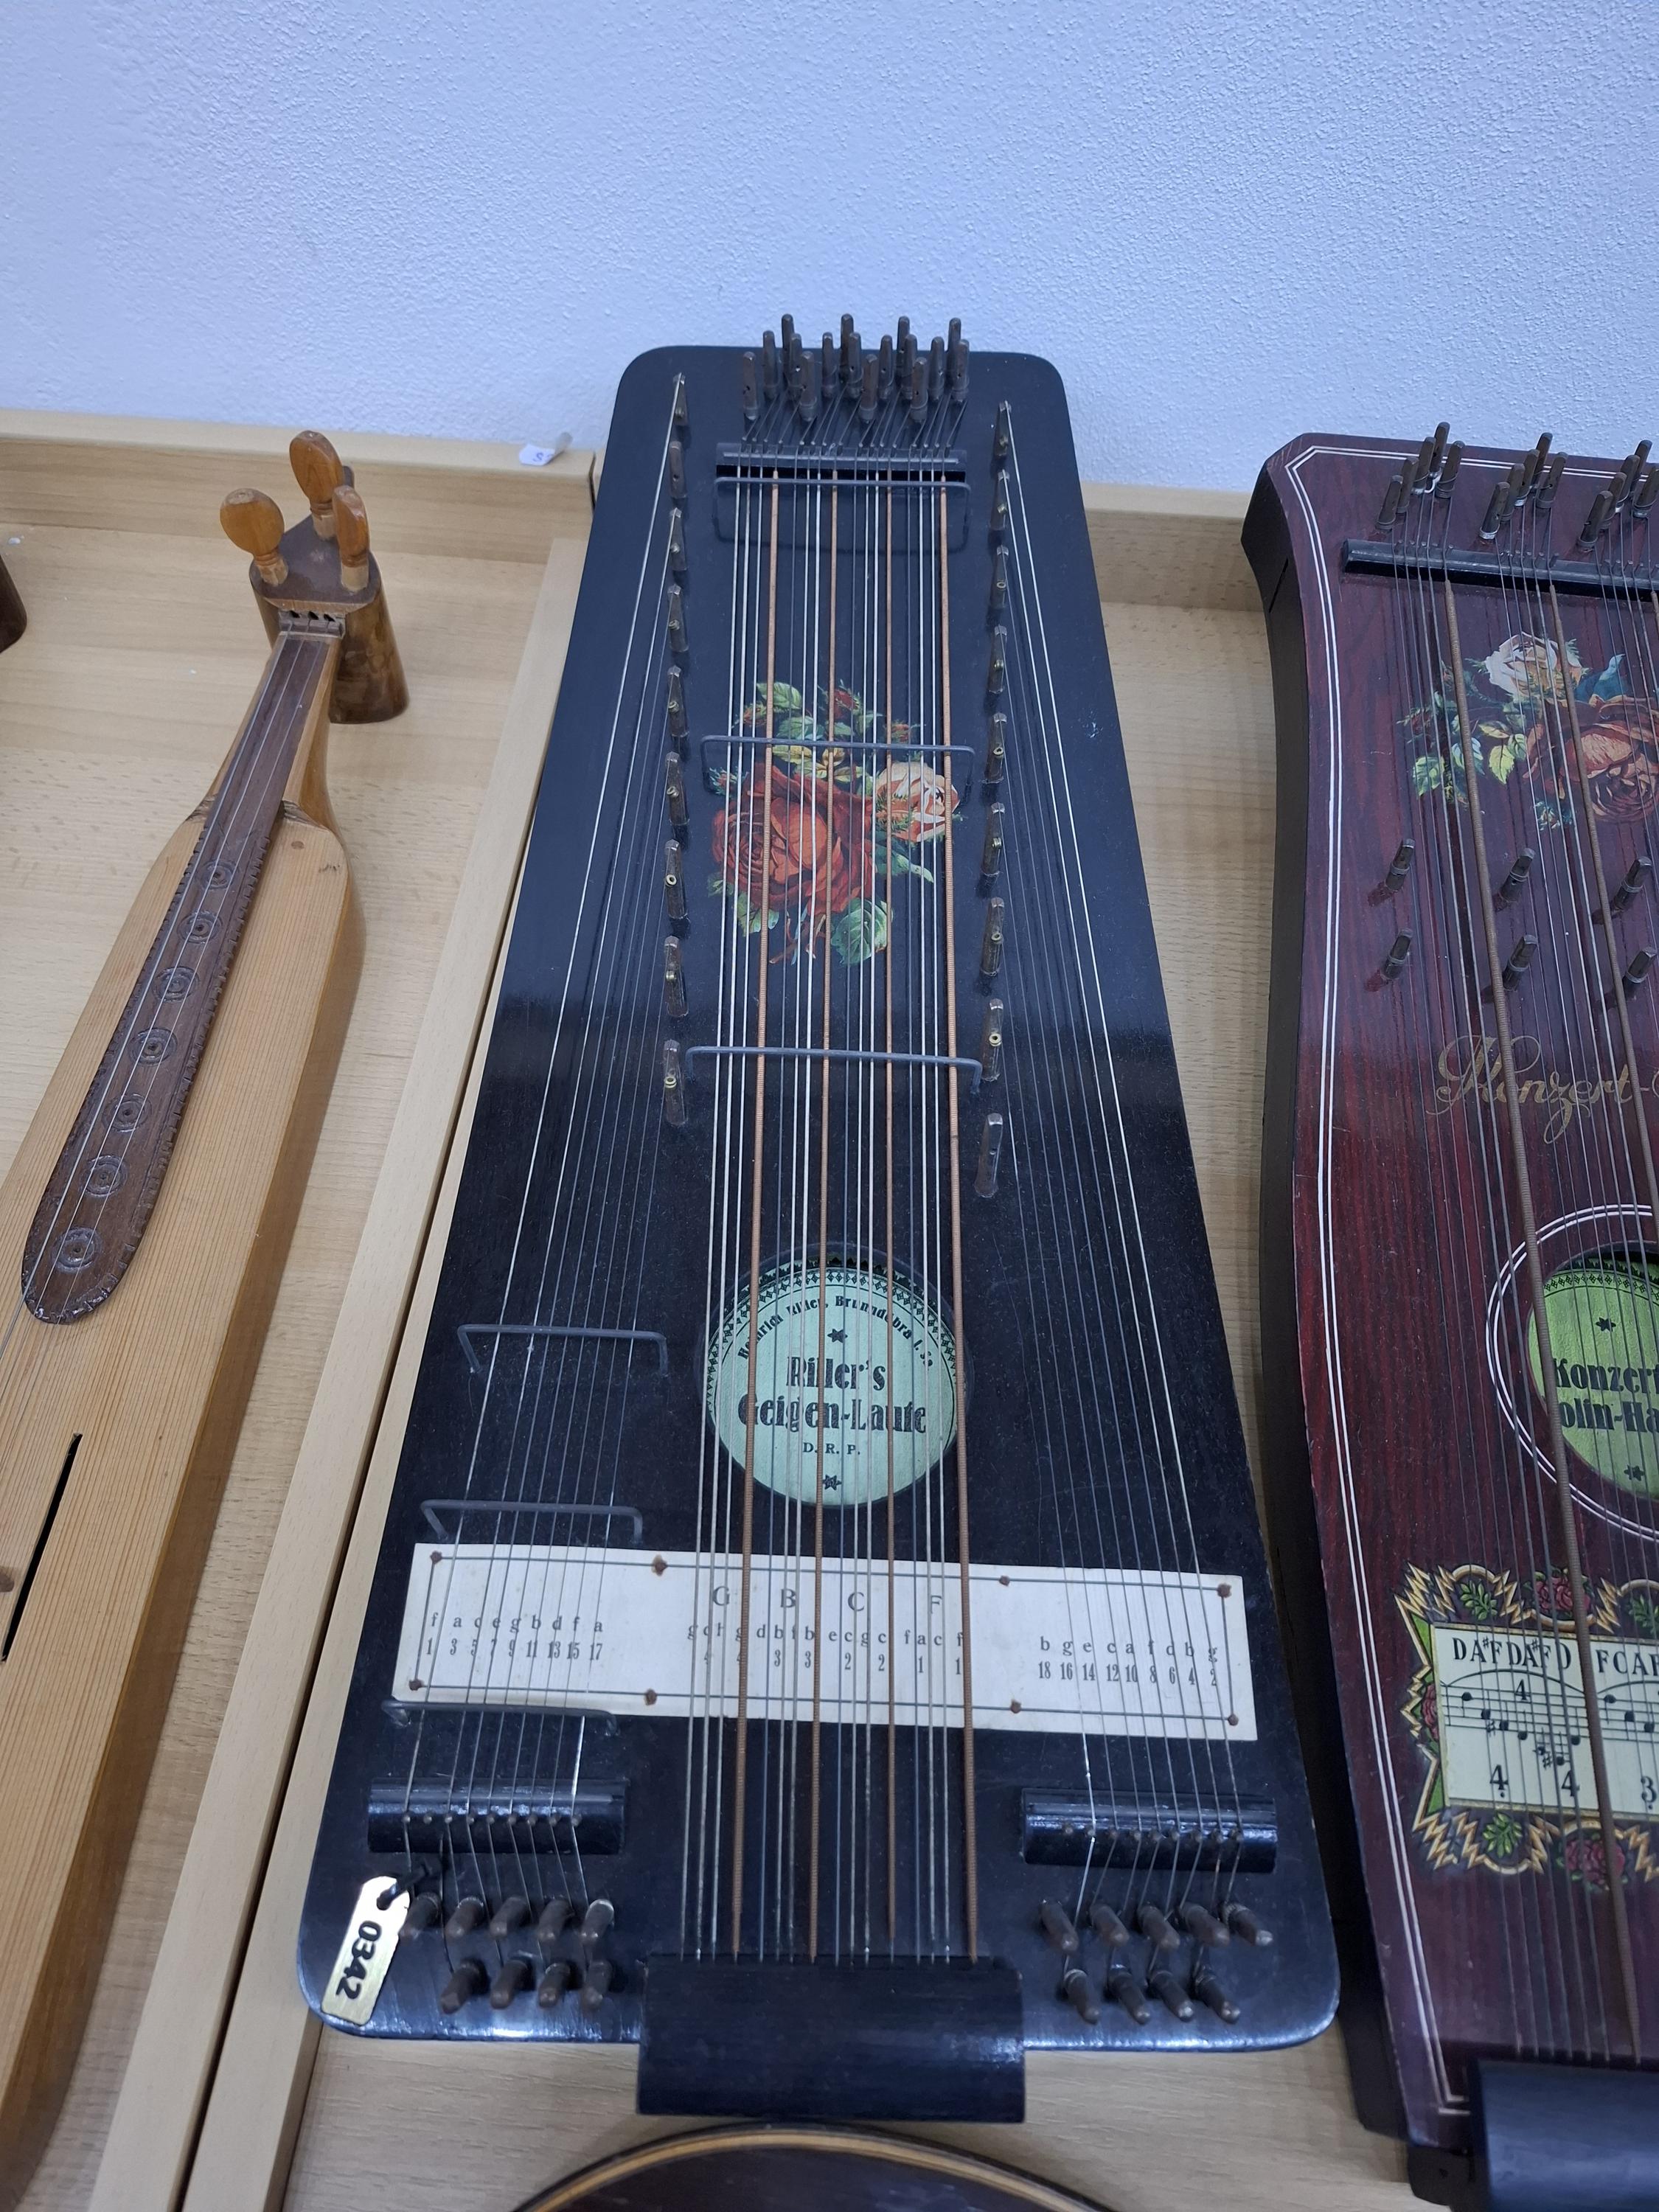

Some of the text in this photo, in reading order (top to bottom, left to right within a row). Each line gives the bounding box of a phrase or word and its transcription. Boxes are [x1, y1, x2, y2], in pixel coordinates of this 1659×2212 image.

[786, 1357, 886, 1391] Riller's
[738, 1393, 927, 1433] Geigen-Laute
[825, 1443, 840, 1454] R.
[847, 1444, 860, 1455] P.
[713, 1585, 942, 1614] G B C F
[431, 1613, 438, 1627] f
[453, 1617, 462, 1627] a
[510, 1618, 521, 1633] g
[532, 1615, 541, 1630] b
[552, 1615, 562, 1630] d
[574, 1616, 580, 1631] f
[594, 1621, 602, 1632] a
[757, 1624, 766, 1638] d
[775, 1624, 784, 1639] b
[804, 1626, 815, 1640] b
[829, 1631, 838, 1641] e
[844, 1632, 852, 1642] c
[878, 1633, 886, 1644] c
[904, 1630, 911, 1644] f
[917, 1634, 926, 1645] a
[934, 1635, 942, 1646] c
[427, 1638, 433, 1655] 1
[450, 1638, 457, 1655] 3
[526, 1640, 538, 1658] 11
[547, 1641, 560, 1658] 13
[567, 1641, 580, 1659] 15
[590, 1642, 602, 1660] 17
[1040, 1635, 1050, 1651] b
[1062, 1641, 1073, 1656] g
[1082, 1642, 1092, 1652] e
[1126, 1643, 1134, 1654] a
[1185, 1641, 1194, 1657] b
[775, 1649, 781, 1666] 3
[804, 1651, 811, 1668] 3
[845, 1652, 851, 1670] 2
[878, 1654, 885, 1672] 2
[919, 1656, 924, 1673] 1
[956, 1658, 961, 1675] 1
[1038, 1660, 1051, 1679] 18
[1060, 1662, 1073, 1680] 16
[1082, 1663, 1095, 1680] 14
[1106, 1664, 1119, 1681] 12
[1125, 1664, 1138, 1682] 10
[1150, 1666, 1157, 1683] 8
[1169, 1666, 1175, 1684] 6
[1189, 1667, 1195, 1685] 4
[335, 1920, 382, 2000] 0342
